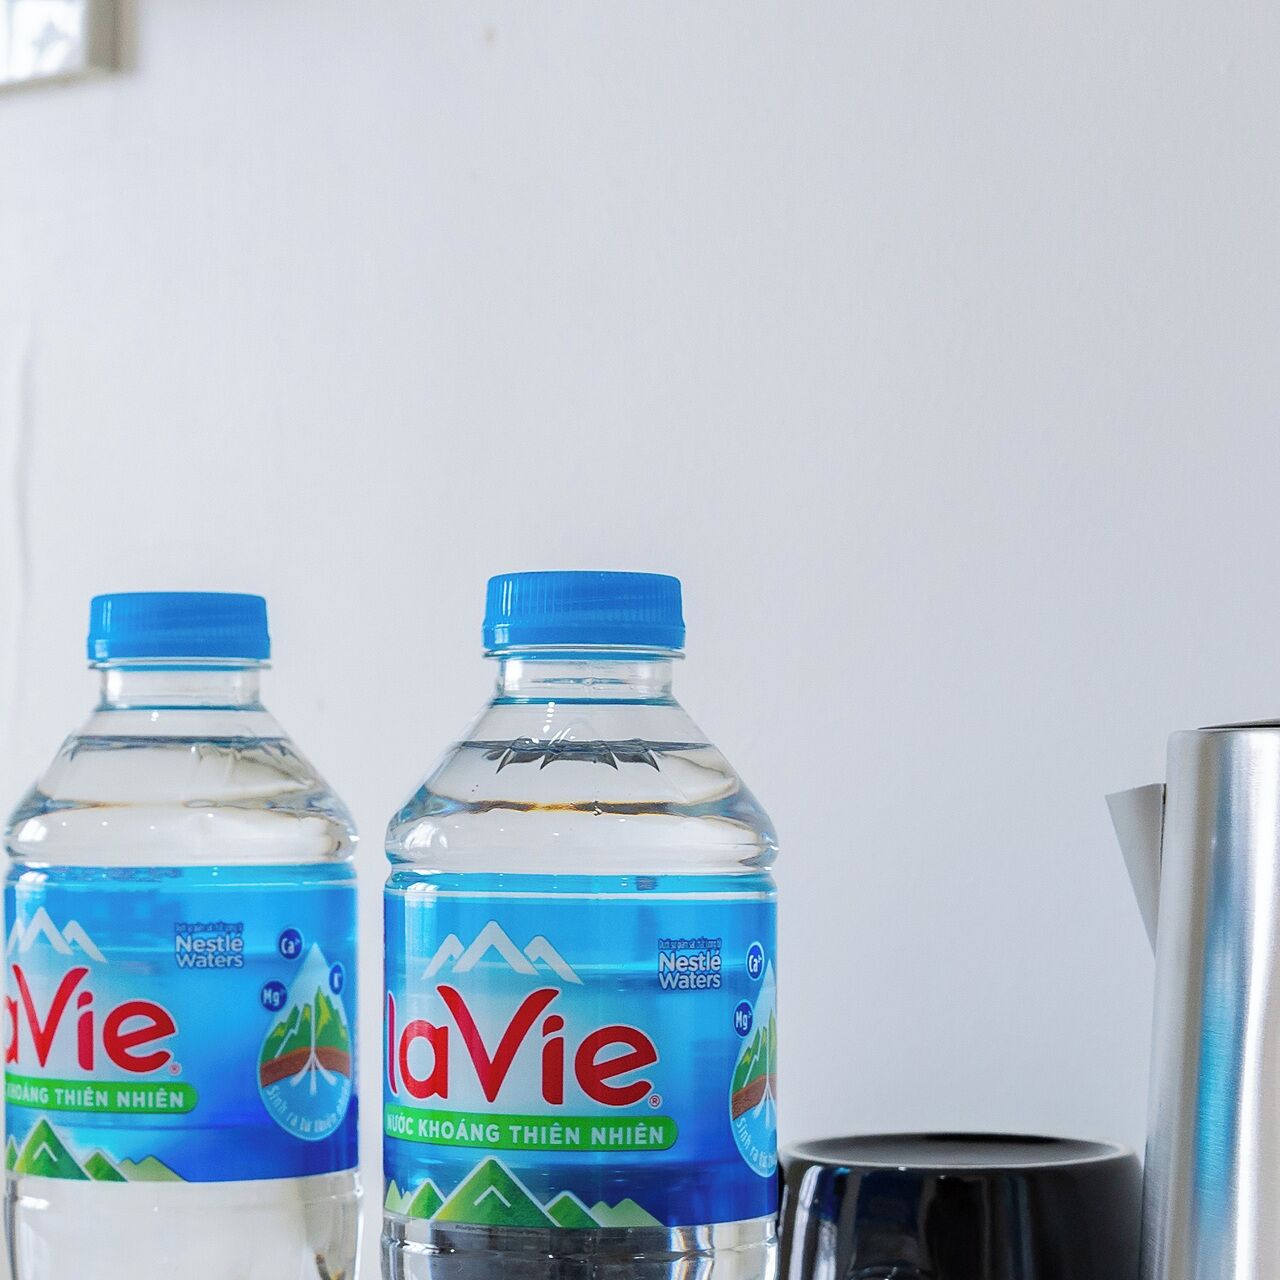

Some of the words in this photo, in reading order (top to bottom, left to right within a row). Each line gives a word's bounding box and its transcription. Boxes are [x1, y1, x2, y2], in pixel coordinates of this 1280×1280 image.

[175, 932, 244, 953] Nestlé
[175, 952, 244, 968] Waters
[658, 950, 721, 972] Nestlé
[658, 971, 721, 990] Waters
[388, 985, 658, 1107] laVie
[54, 1086, 109, 1107] THIÊN
[116, 1088, 184, 1108] NHIÊN
[418, 1118, 500, 1143] KHOÁNG
[508, 1122, 580, 1145] THIÊN
[591, 1122, 664, 1145] NHIÊN
[736, 1116, 751, 1150] Sinh
